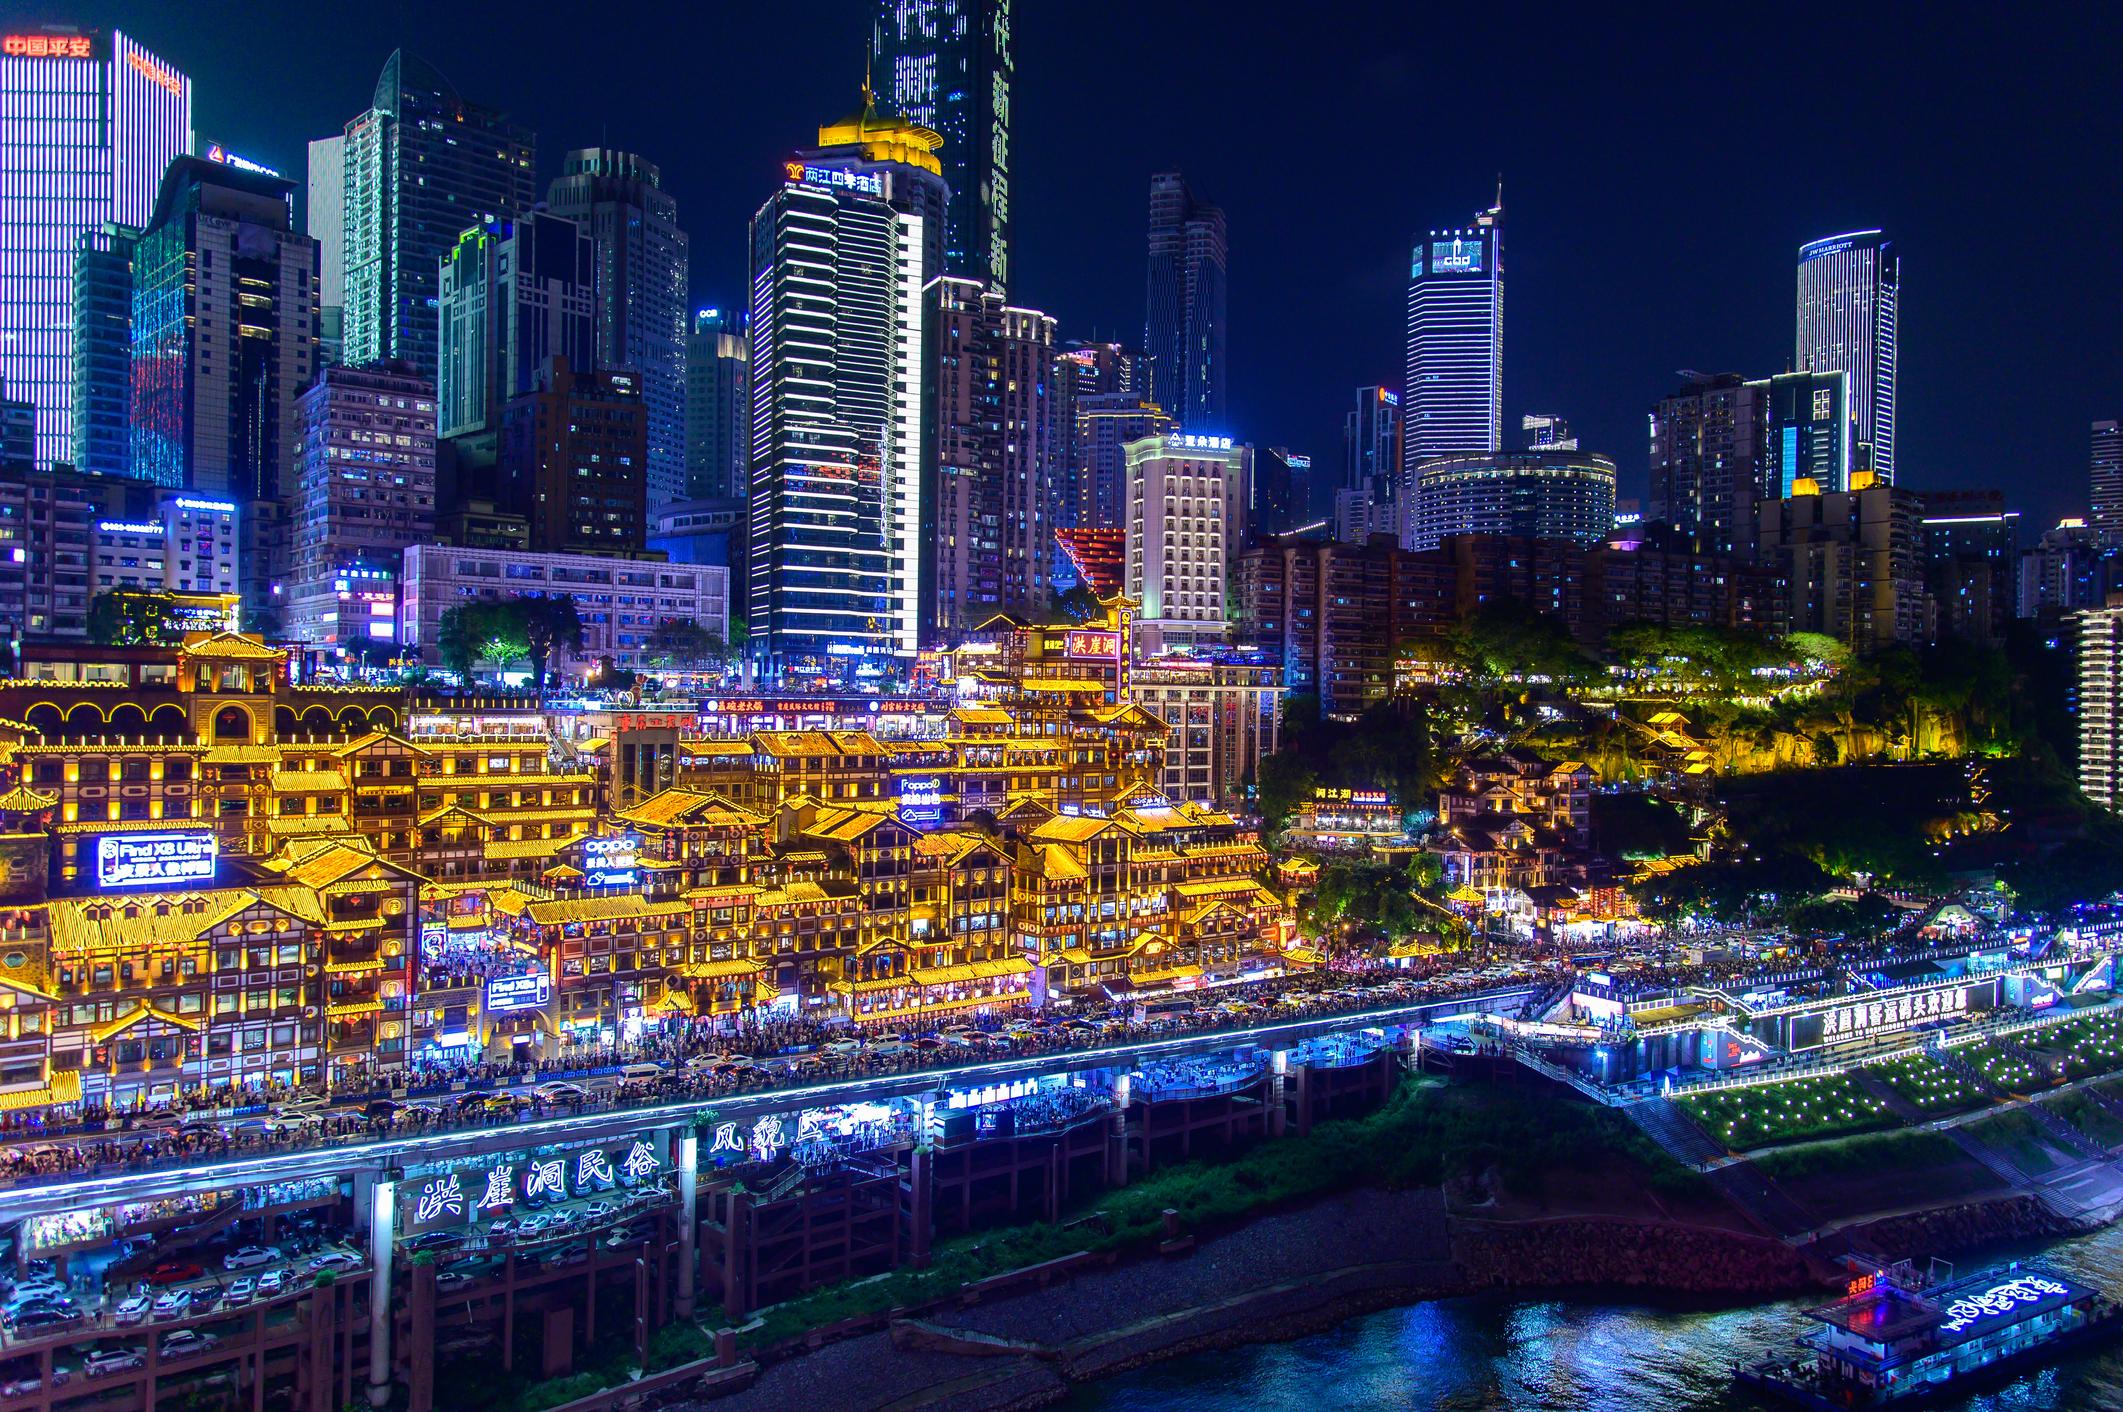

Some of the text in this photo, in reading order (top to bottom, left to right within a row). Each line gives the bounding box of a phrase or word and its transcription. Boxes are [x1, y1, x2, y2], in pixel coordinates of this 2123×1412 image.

[5, 34, 91, 57] 中国平安
[128, 51, 182, 97] 中国平安
[805, 166, 882, 194] 两江四季酒店
[1820, 241, 1853, 252] MARRIOTT
[1072, 634, 1116, 655] 洪崖洞
[120, 843, 152, 857] Find
[492, 981, 515, 993] Find
[1823, 988, 1967, 1035] 洪崖洞客运码头欢迎您
[418, 1107, 822, 1220] 洪崖洞民俗风貌区
